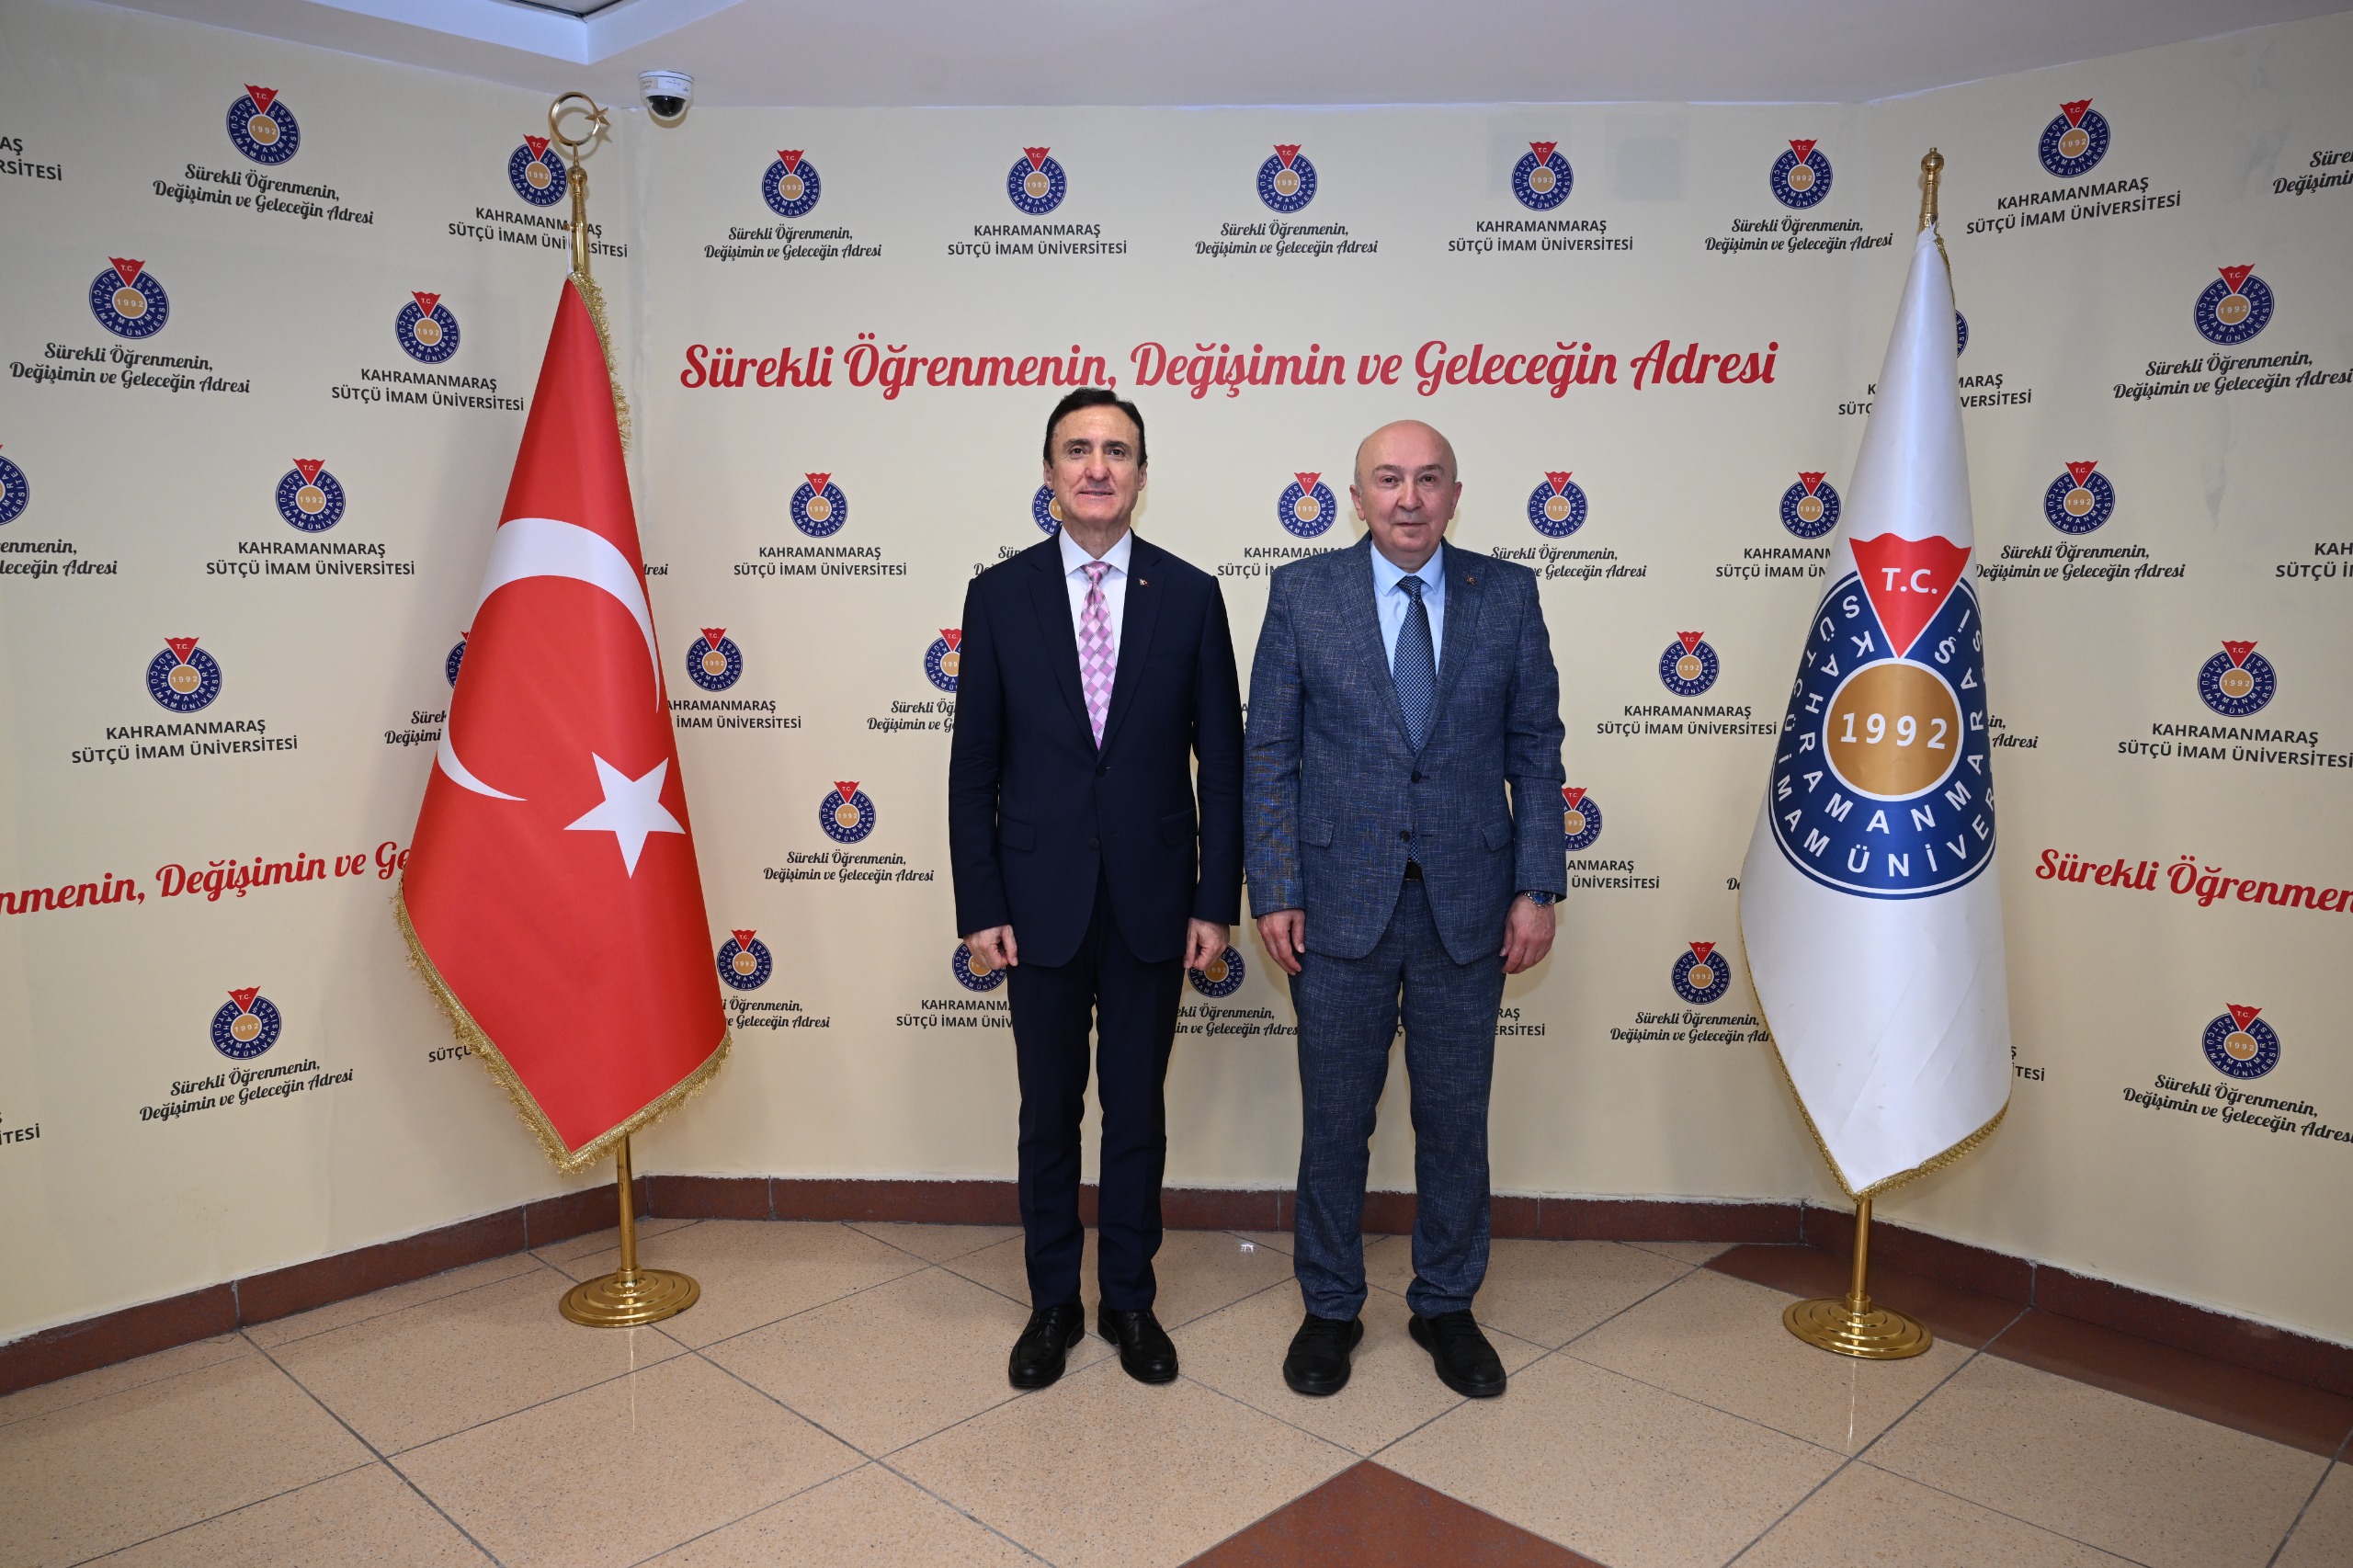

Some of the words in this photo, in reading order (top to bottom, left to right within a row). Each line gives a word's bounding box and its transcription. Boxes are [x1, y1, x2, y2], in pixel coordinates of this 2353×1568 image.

[256, 92, 269, 100] T.C.
[251, 124, 277, 135] 1992
[185, 164, 242, 186] Sürekli
[245, 169, 339, 201] Öğrenmenin,
[153, 180, 232, 205] Değişimin
[236, 196, 251, 207] ve
[256, 195, 323, 220] Geleceğin
[327, 206, 373, 224] Adresi
[1998, 177, 2148, 210] KAHRAMANMARAŞ
[1967, 214, 2015, 234] SÜTÇÜ
[2021, 210, 2064, 227] İMAM
[2071, 190, 2180, 220] ÜNİVERSİTESİ
[476, 208, 602, 237] KAHRAMANMAŞ
[974, 224, 1100, 238] KAHRAMANMARAŞ
[1221, 223, 1266, 235] Sürekli
[1269, 222, 1348, 239] Öğrenmenin,
[1477, 221, 1607, 234] KAHRAMANMARAŞ
[1732, 219, 1779, 232] Sürekli
[1781, 215, 1863, 235] Öğrenmenin,
[449, 222, 494, 244] SÜTÇÜ
[498, 227, 537, 247] İMAM
[541, 233, 628, 258] ÜNİSİTESİ
[729, 227, 772, 240] Sürekli
[776, 227, 852, 243] Öğrenmenin,
[1705, 237, 1768, 254] Değişimin
[1771, 241, 1784, 250] ve
[1788, 237, 1847, 254] Geleceğin
[1850, 233, 1893, 251] Adresi
[704, 245, 764, 261] Değişimin
[767, 248, 779, 257] ve
[783, 244, 838, 260] Geleceğin
[842, 244, 881, 258] Adresi
[949, 244, 990, 257] SÜTÇÜ
[996, 244, 1033, 255] İMAM
[1039, 244, 1126, 254] ÜNİVERSİTESİ
[1196, 242, 1256, 257] Değişimin
[1260, 244, 1272, 253] ve
[1276, 241, 1333, 256] Geleceğin
[1336, 240, 1378, 255] Adresi
[1449, 241, 1493, 255] SÜTÇÜ
[1498, 237, 1536, 251] İMAM
[1541, 236, 1632, 251] ÜNİVERSİTESİ
[117, 299, 143, 308] 1992
[2221, 305, 2247, 313] 1992
[45, 343, 106, 362] Sürekli
[110, 345, 212, 372] Öğrenmenin,
[680, 345, 834, 388] Sürekli
[844, 333, 1116, 400] Öğrenmenin,
[1131, 342, 1346, 399] Değişimin
[1358, 355, 1403, 384] ve
[1415, 341, 1617, 398] Geleceğin
[1631, 340, 1779, 390] Adresi
[2145, 358, 2203, 376] Sürekli
[2207, 351, 2313, 375] Öğrenmenin,
[10, 362, 96, 384] Değişimin
[100, 373, 117, 383] ve
[121, 370, 195, 392] Geleceğin
[199, 376, 250, 392] Adresi
[361, 369, 496, 392] KAHRAMANMARAŞ
[2113, 381, 2189, 401] Değişimin
[2193, 382, 2210, 392] ve
[2214, 373, 2290, 395] Geleceğin
[2295, 369, 2353, 388] Adresi
[332, 384, 381, 403] SÜTÇÜ
[386, 388, 427, 404] İMAM
[433, 392, 523, 411] ÜNİVERSİTESİ
[1961, 390, 2031, 408] VERSİTESİ
[239, 542, 385, 558] KAHRAMANMARAŞ
[759, 547, 881, 560] KAHRAMANMARAŞ
[1491, 546, 1536, 561] Sürekli
[1538, 543, 1618, 563] Öğrenmenin,
[2001, 545, 2052, 559] Sürekli
[2055, 541, 2149, 562] Öğrenmenin,
[0, 560, 58, 579] leceğin
[63, 560, 118, 576] Adresi
[207, 560, 259, 578] SÜTÇÜ
[266, 560, 310, 574] İMAM
[316, 561, 414, 574] ÜNİVERSİTESİ
[734, 565, 775, 578] SÜTÇÜ
[780, 565, 816, 574] İMAM
[822, 565, 906, 575] ÜNİVERSİTESİ
[2043, 568, 2059, 577] ve
[2063, 563, 2130, 582] Geleceğin
[2134, 563, 2186, 579] Adresi
[2276, 562, 2336, 581] SÜTÇÜ
[1881, 567, 1938, 595] T.C.
[666, 699, 776, 713] AHRAMANMARAŞ
[892, 701, 934, 713] Sürekli
[1625, 706, 1751, 720] KAHRAMANMARAŞ
[107, 720, 266, 740] KAHRAMANMARAŞ
[676, 715, 712, 728] İMAM
[717, 718, 801, 728] ÜNİVERSİTESİ
[1597, 722, 1640, 736] SÜTÇÜ
[1645, 722, 1683, 733] İMAM
[1688, 722, 1777, 735] ÜNİVERSİTESİ
[1840, 712, 1949, 750] 1992
[385, 728, 441, 746] Değişimi
[1992, 733, 2039, 749] Adresi
[2153, 723, 2318, 747] KAHRAMANMARAŞ
[72, 747, 129, 765] SÜTÇÜ
[136, 744, 184, 759] İMAM
[190, 738, 297, 756] ÜNİVERSİTESİ
[2119, 740, 2171, 758] SÜTÇÜ
[2177, 743, 2226, 759] İMAM
[2233, 746, 2353, 767] ÜNİVERSİTESİ
[787, 851, 829, 863] Sürekli
[832, 852, 905, 867] Öğrenmenin,
[0, 873, 145, 915] nmenin,
[156, 853, 325, 902] Değişimin
[335, 854, 366, 877] ve
[764, 868, 821, 882] Değişimin
[839, 869, 892, 884] Geleceğin
[895, 869, 934, 881] Adresi
[1572, 875, 1659, 888] ÜNİVERSİTESİ
[2036, 849, 2159, 891] Sürekli
[2167, 855, 2353, 912] Öğrenmen
[730, 999, 802, 1014] Öğrenmenin,
[1199, 1003, 1275, 1020] Öğrenmenin,
[897, 1017, 937, 1028] SÜTÇÜ
[942, 1015, 977, 1027] İMAM
[1635, 1012, 1679, 1024] Sürekli
[1682, 1013, 1759, 1028] Öğrenmenin,
[1610, 1028, 1670, 1043] Değişimin
[1673, 1032, 1686, 1040] ve
[1688, 1029, 1744, 1045] Geleceğin
[2228, 1041, 2255, 1051] 1992
[171, 1074, 225, 1096] Sürekli
[229, 1059, 320, 1086] Öğrenmenin,
[140, 1096, 215, 1121] Değişimin
[220, 1095, 234, 1106] ve
[239, 1080, 304, 1105] Geleceğin
[308, 1069, 353, 1090] Adresi
[2154, 1074, 2211, 1096] Sürekli
[2214, 1083, 2317, 1118] Öğrenmenin,
[2123, 1088, 2198, 1113] Değişimin
[2201, 1107, 2218, 1117] ve
[2222, 1107, 2296, 1132] Geleceğin
